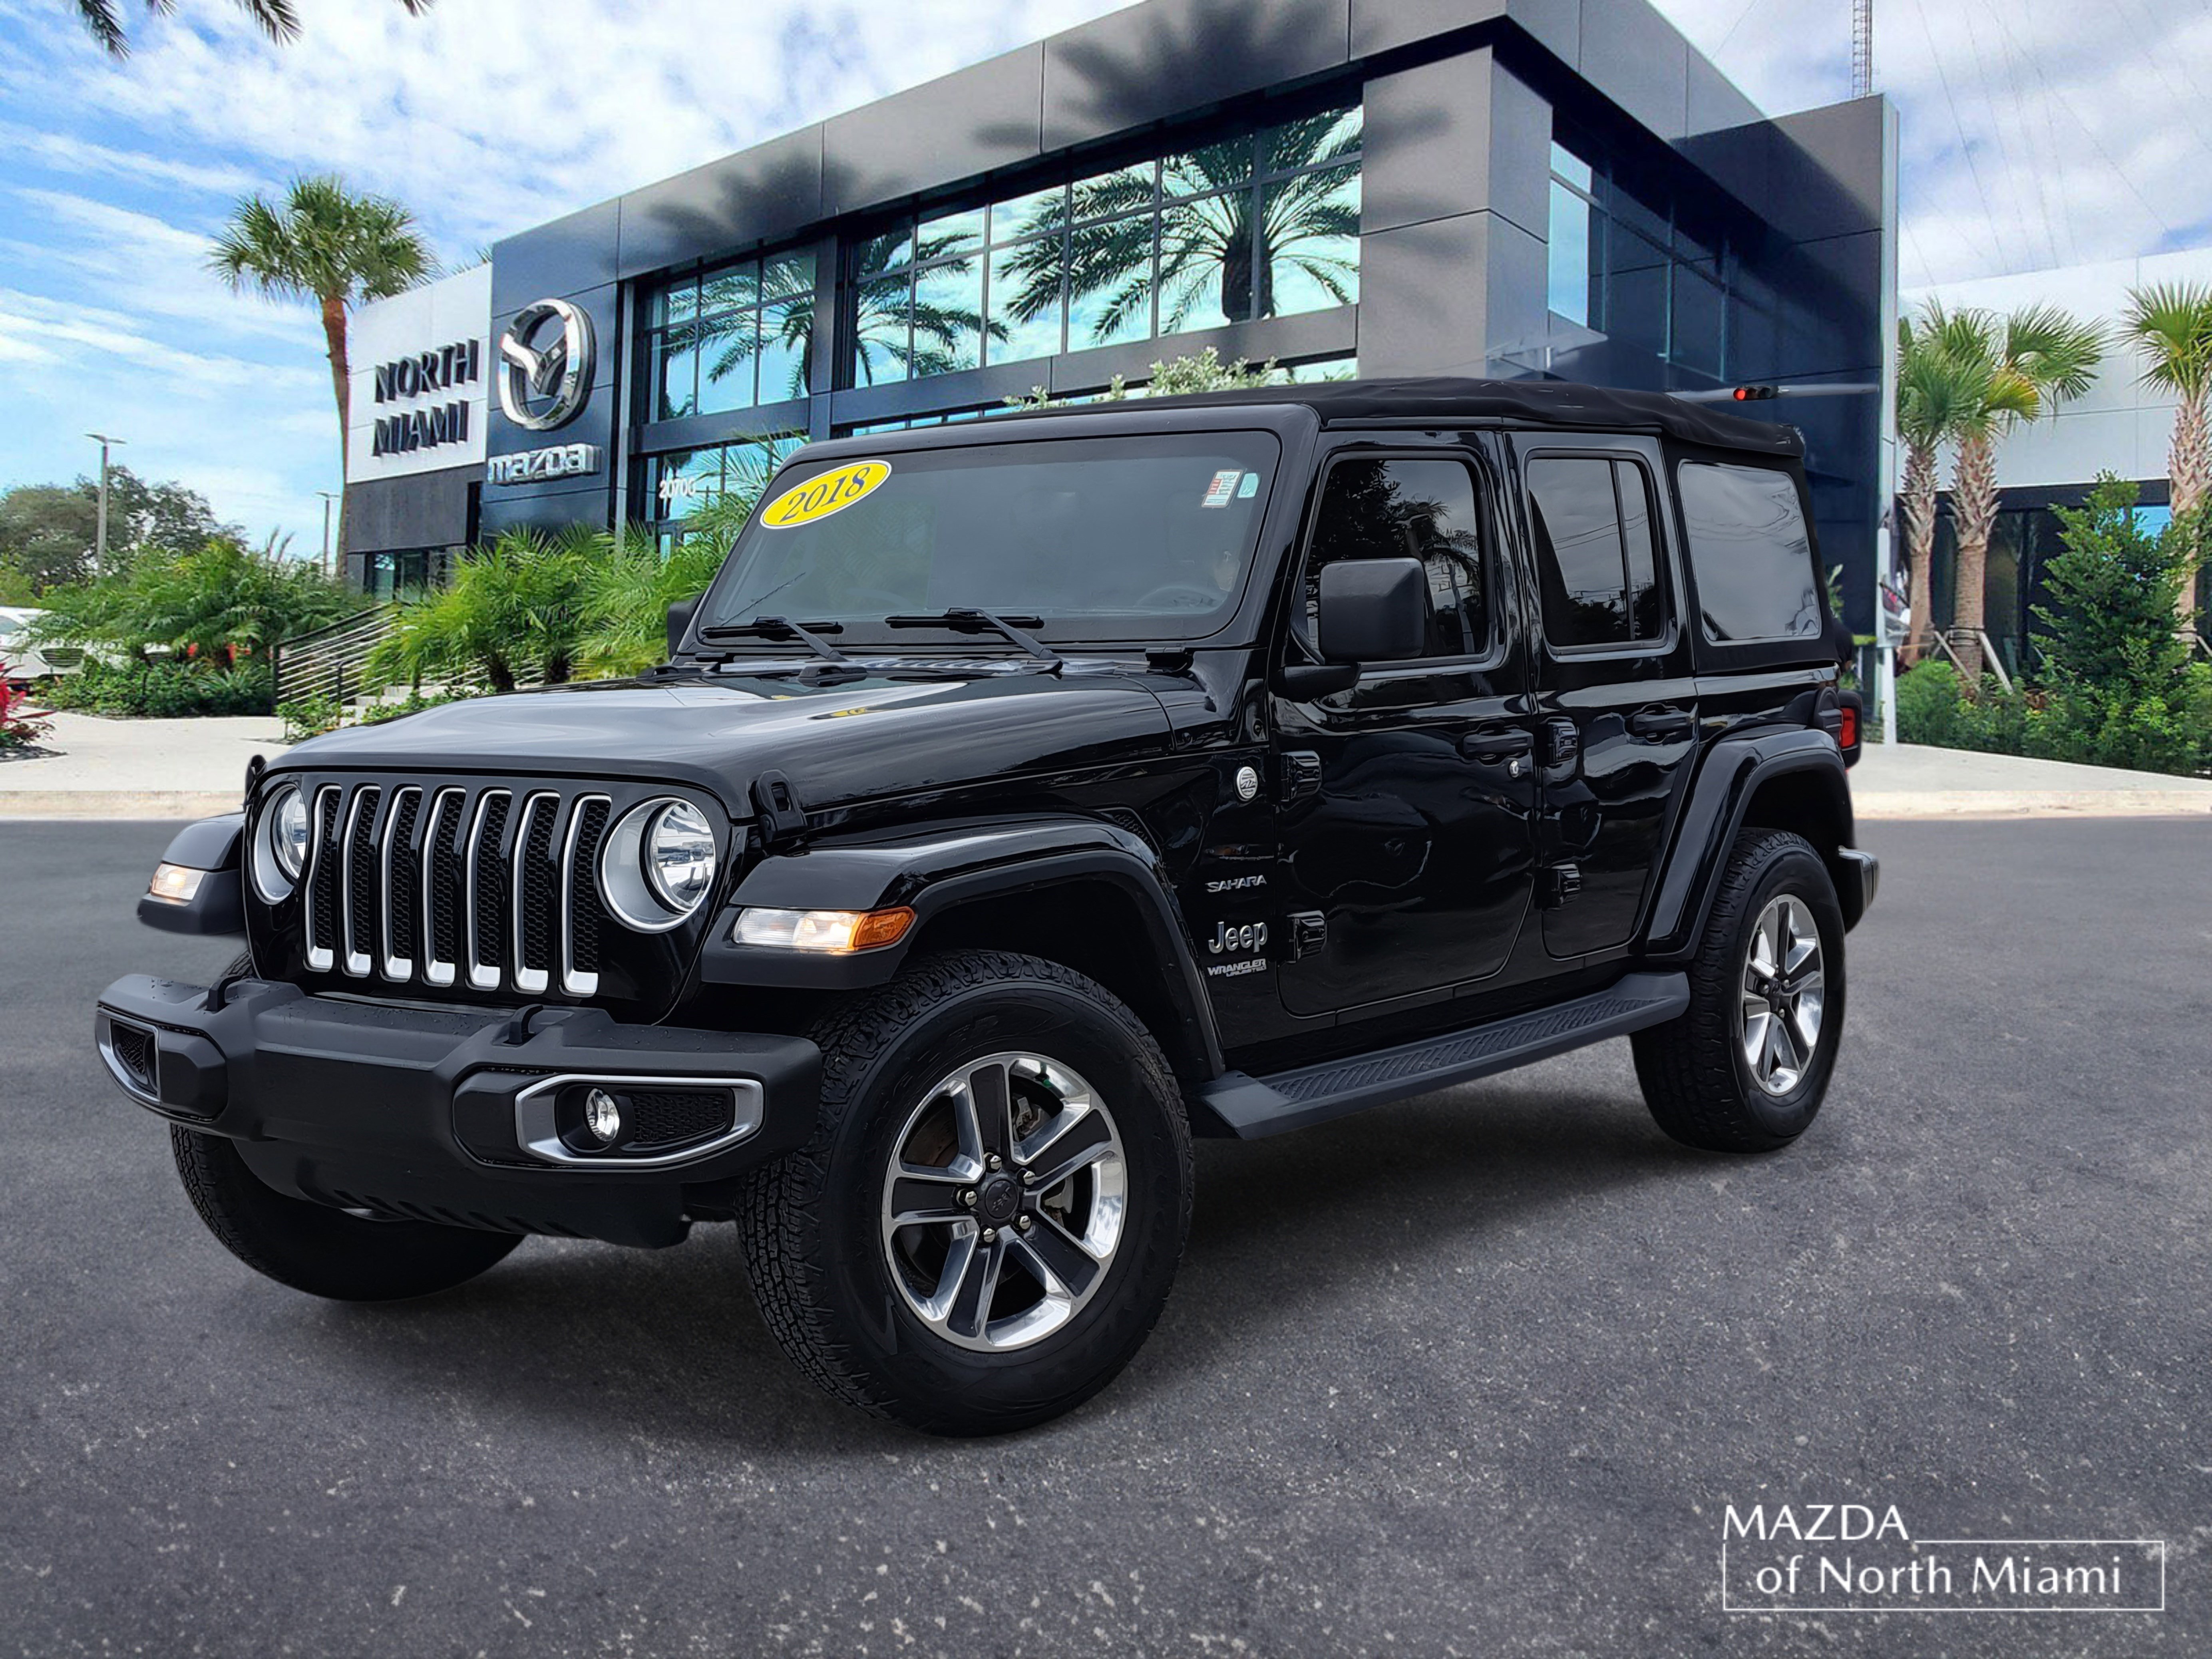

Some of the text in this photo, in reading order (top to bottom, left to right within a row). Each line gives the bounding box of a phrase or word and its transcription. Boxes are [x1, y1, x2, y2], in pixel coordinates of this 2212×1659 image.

[375, 338, 479, 403] NORTH
[372, 400, 469, 456] MIAMI
[659, 478, 696, 498] 20700
[779, 467, 870, 523] 2018
[1205, 875, 1267, 893] SAHARA
[1208, 921, 1268, 953] Jeep
[1207, 958, 1266, 976] WRANGLER
